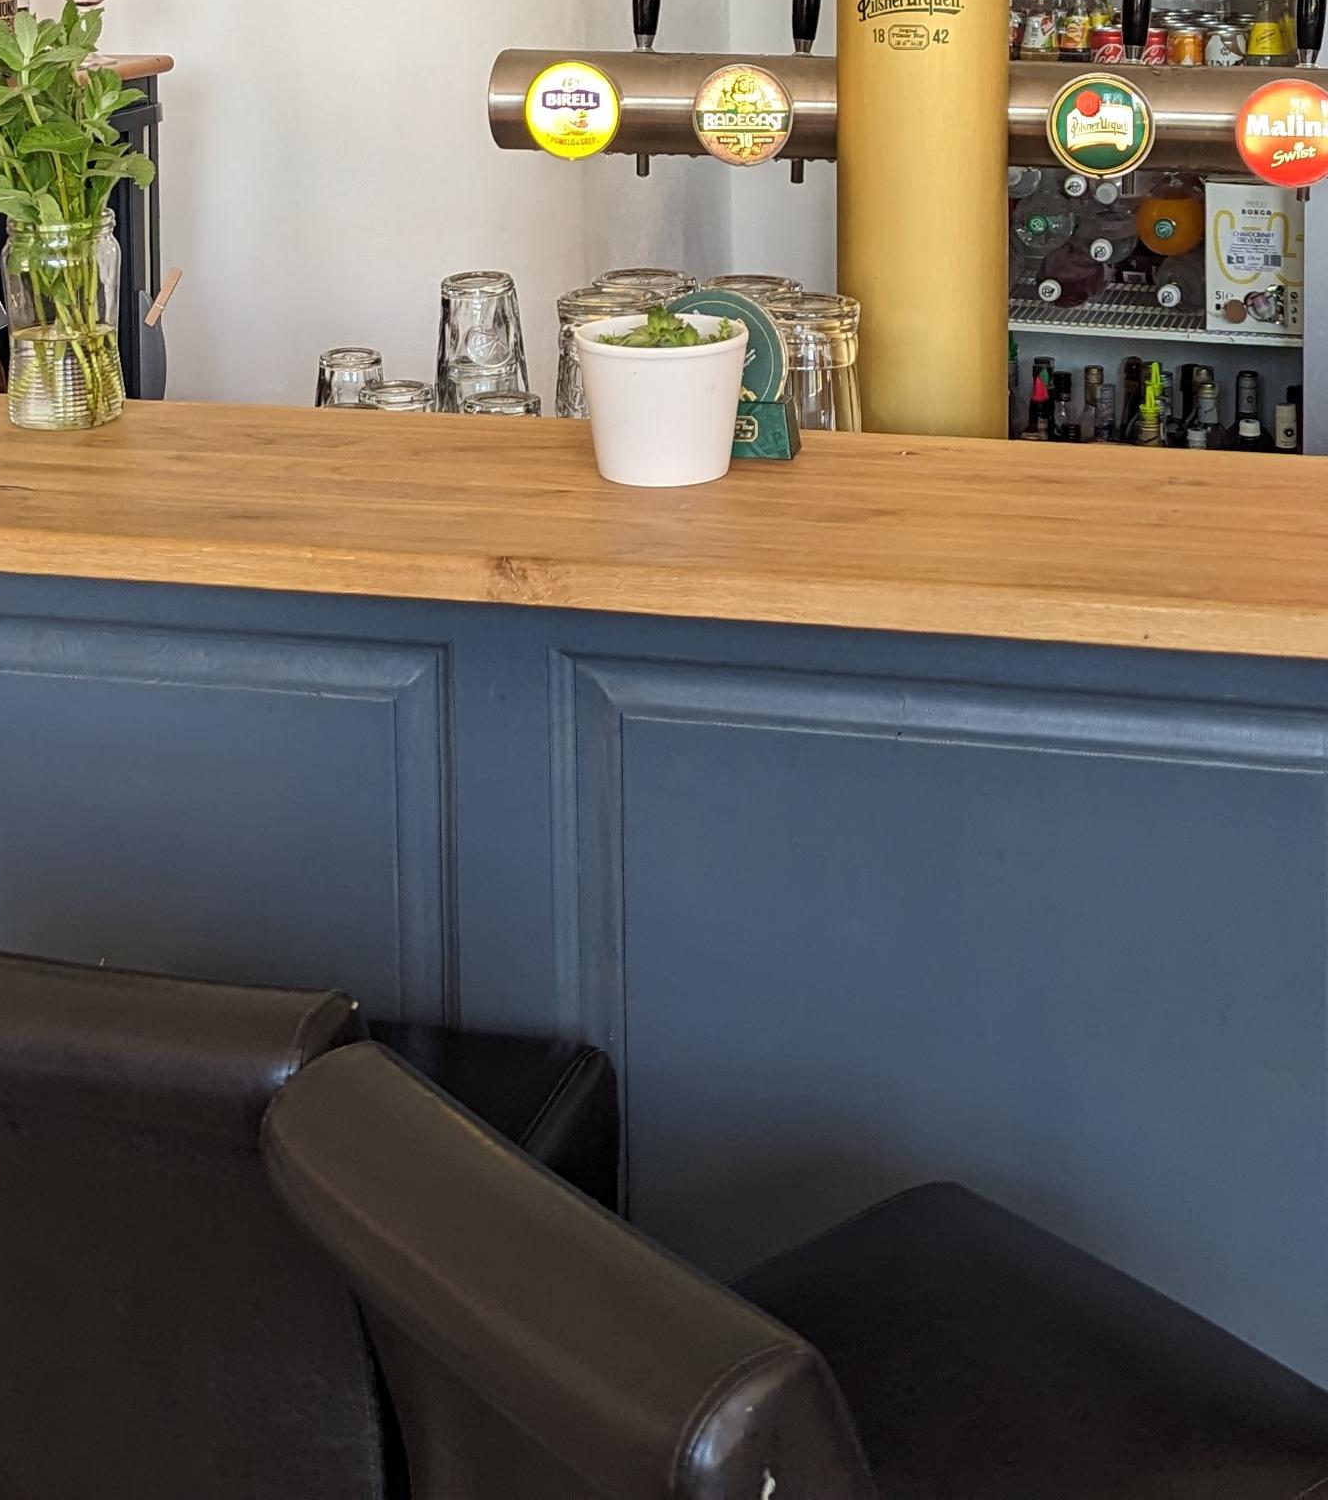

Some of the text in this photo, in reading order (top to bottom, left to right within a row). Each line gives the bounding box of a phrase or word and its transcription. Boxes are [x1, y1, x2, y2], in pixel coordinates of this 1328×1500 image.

[872, 28, 885, 44] 18
[932, 29, 949, 44] 42
[545, 93, 598, 107] BIRELL
[703, 112, 786, 131] RADEGAST
[1270, 141, 1317, 168] Swist
